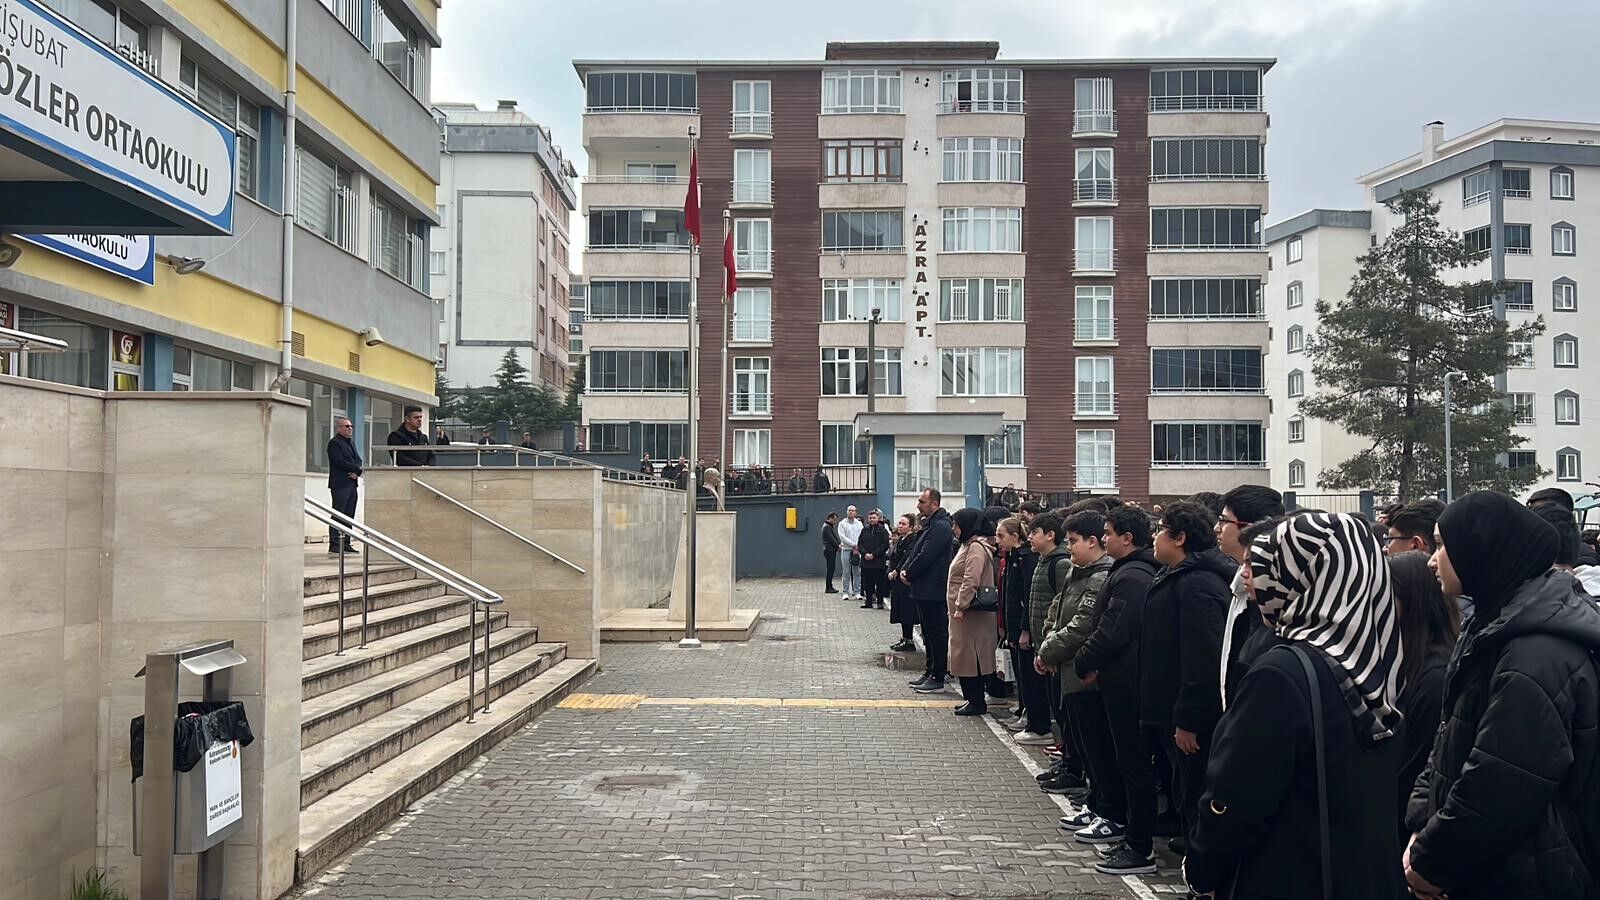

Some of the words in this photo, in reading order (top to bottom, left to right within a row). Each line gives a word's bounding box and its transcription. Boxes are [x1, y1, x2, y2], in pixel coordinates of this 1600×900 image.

[0, 3, 68, 68] İŞUBAT
[86, 105, 209, 196] ORTAOKULU
[915, 225, 927, 283] AZRA
